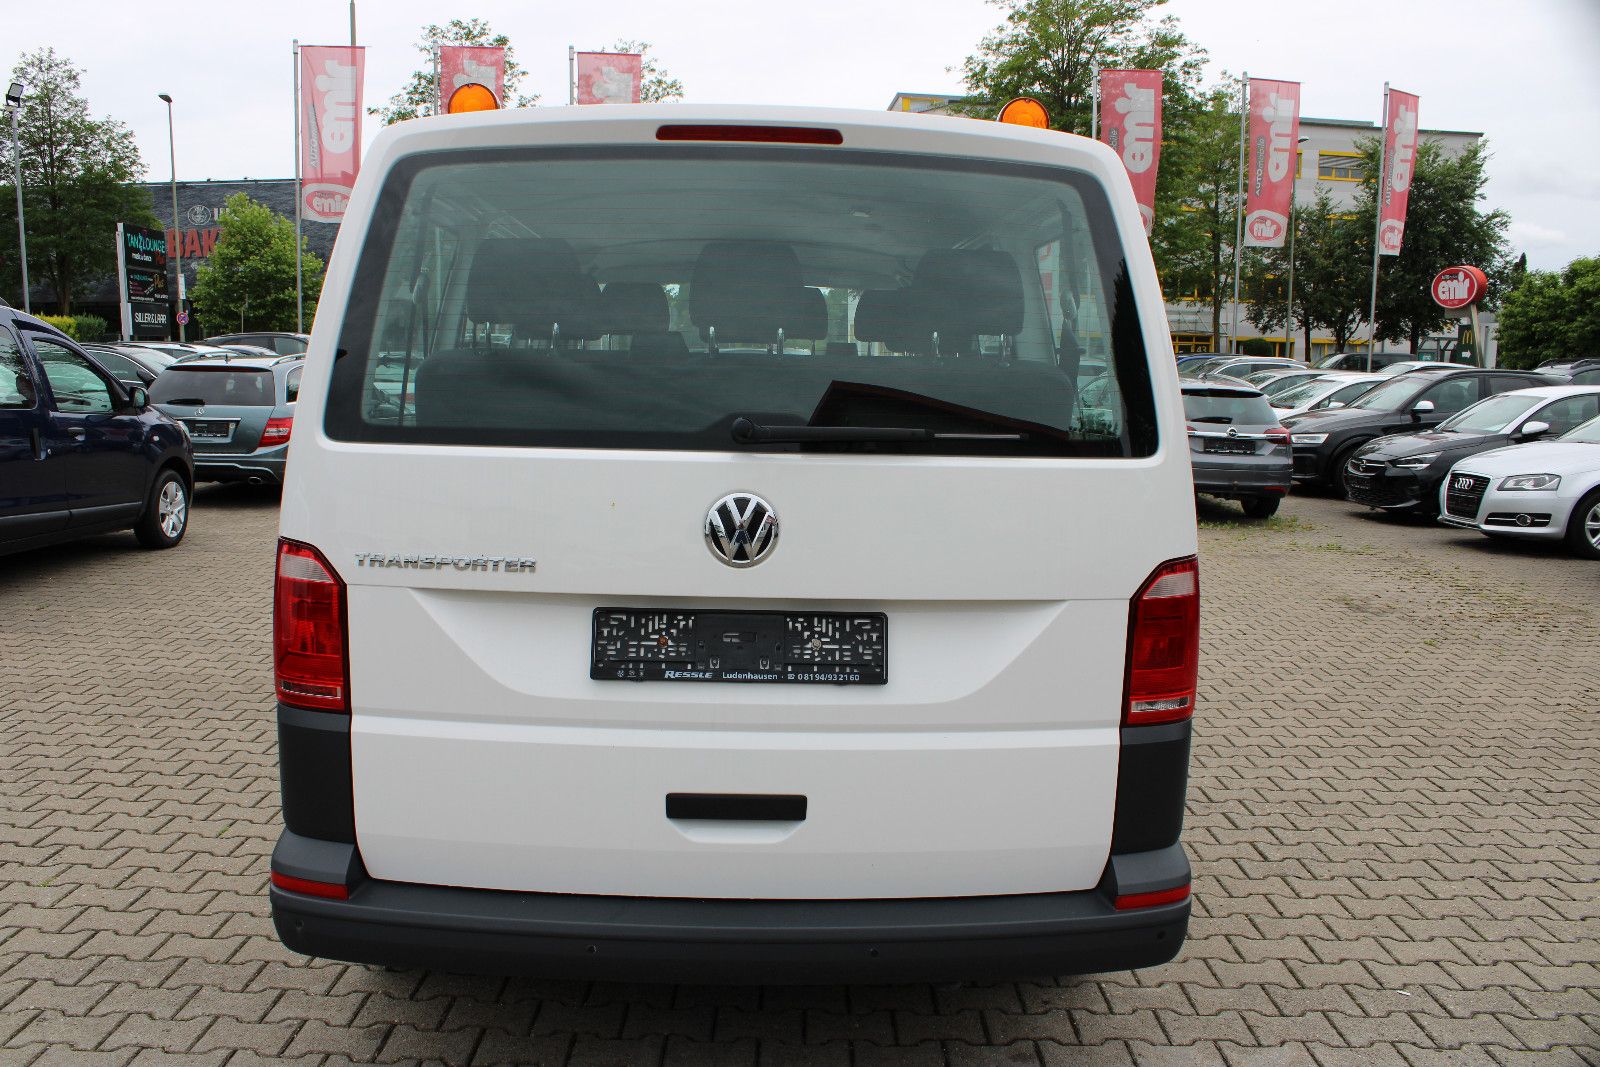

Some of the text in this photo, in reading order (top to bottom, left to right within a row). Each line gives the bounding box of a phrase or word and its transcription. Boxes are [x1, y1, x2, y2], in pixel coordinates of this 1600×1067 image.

[315, 60, 357, 154] emir
[1115, 83, 1155, 173] emir
[1262, 92, 1295, 182] emir
[1391, 104, 1417, 193] emir
[1437, 271, 1470, 300] emir
[355, 552, 536, 574] TRANSPORTER
[664, 670, 713, 679] RESSLE
[722, 671, 778, 680] Ludenhausen
